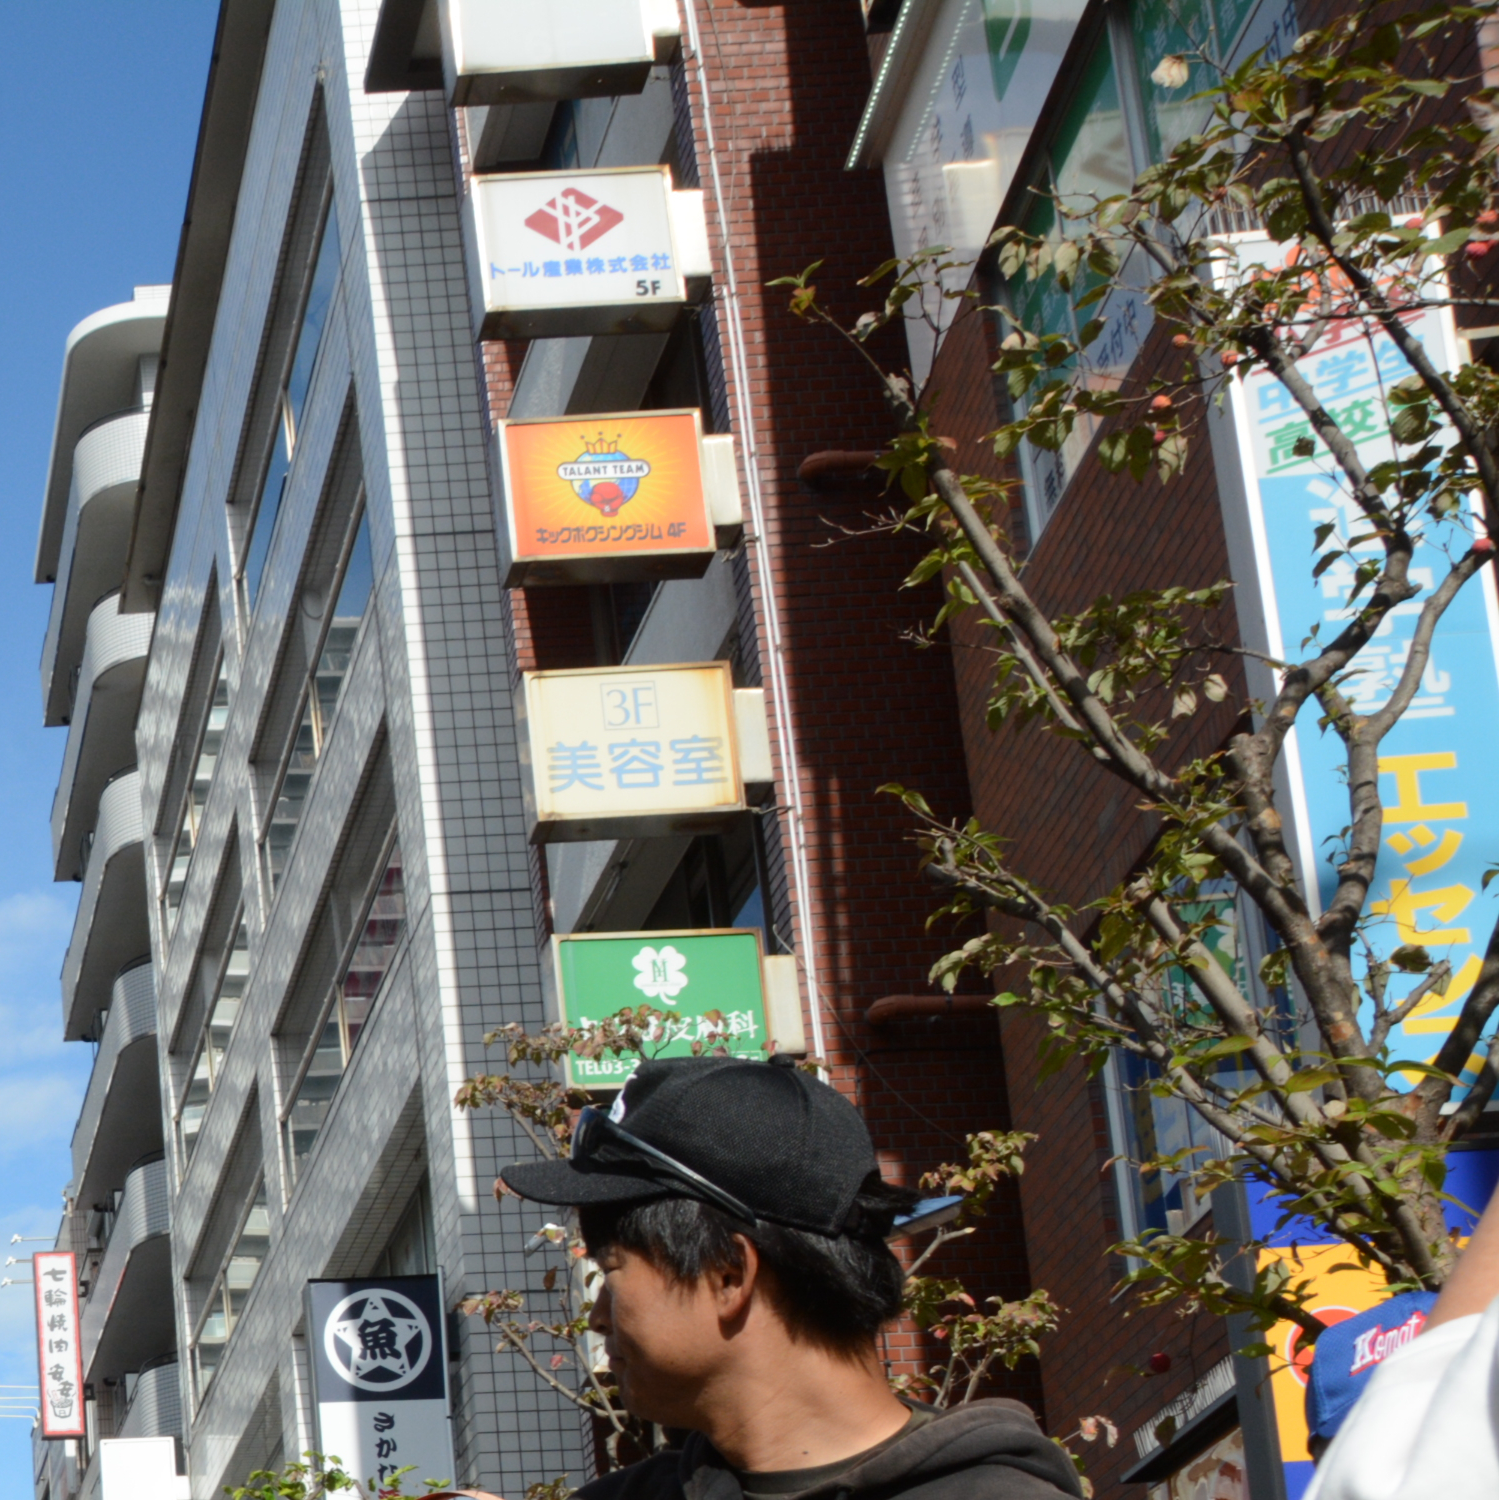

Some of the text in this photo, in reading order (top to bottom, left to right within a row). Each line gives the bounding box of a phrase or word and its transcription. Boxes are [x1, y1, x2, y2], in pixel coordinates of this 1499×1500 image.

[489, 253, 671, 280] トール産業株式会社
[635, 280, 661, 296] 5F
[562, 462, 645, 477] TALANT TEAM
[605, 687, 654, 728] 3F
[546, 735, 729, 793] 美容室
[357, 1318, 402, 1362] 魚
